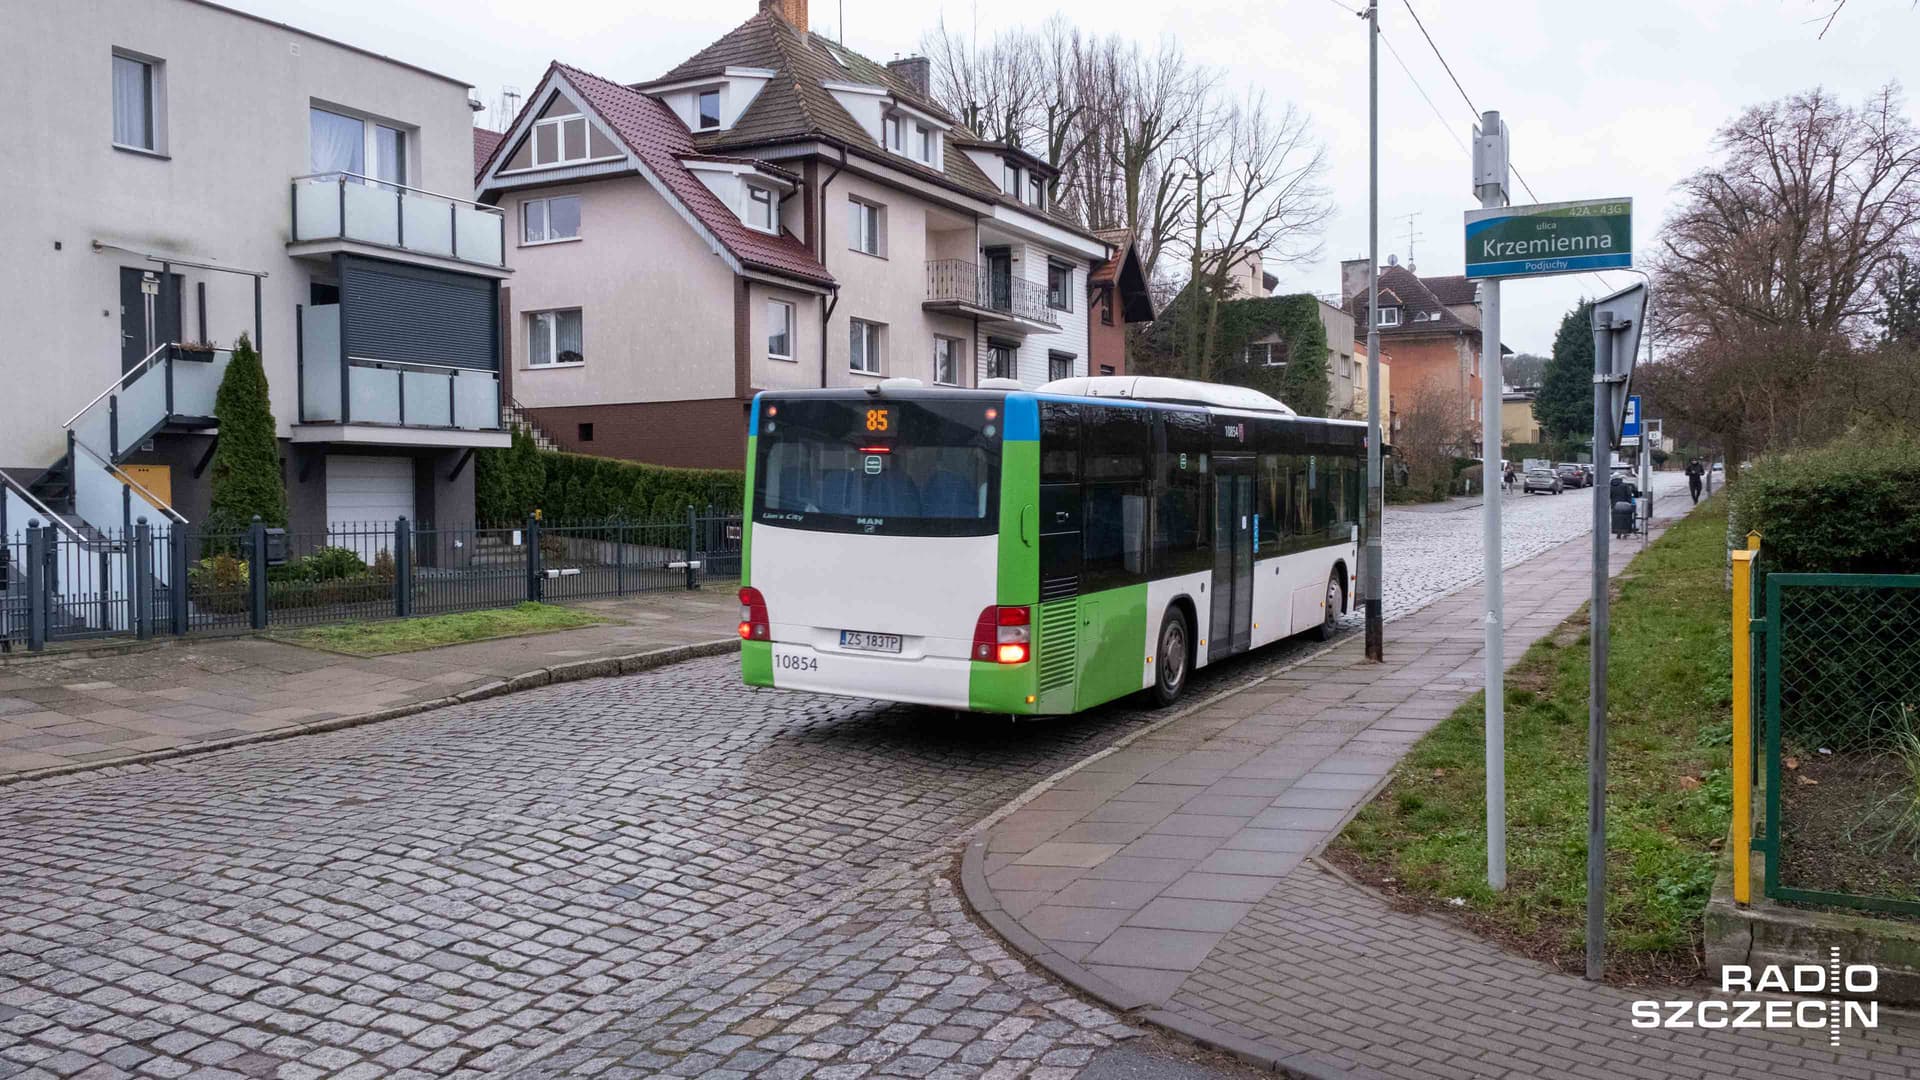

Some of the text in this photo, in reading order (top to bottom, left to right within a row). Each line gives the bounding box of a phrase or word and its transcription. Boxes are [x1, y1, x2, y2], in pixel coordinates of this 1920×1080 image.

[1569, 206, 1590, 217] 42A
[1600, 204, 1622, 215] 43G
[1536, 222, 1557, 231] ulica
[1483, 234, 1612, 257] Krzemienna
[1525, 260, 1568, 272] Podjuchy
[866, 409, 888, 431] 85
[786, 513, 804, 521] City
[856, 518, 884, 526] MAN
[847, 633, 898, 649] ZS 183TP
[775, 654, 818, 671] 10854
